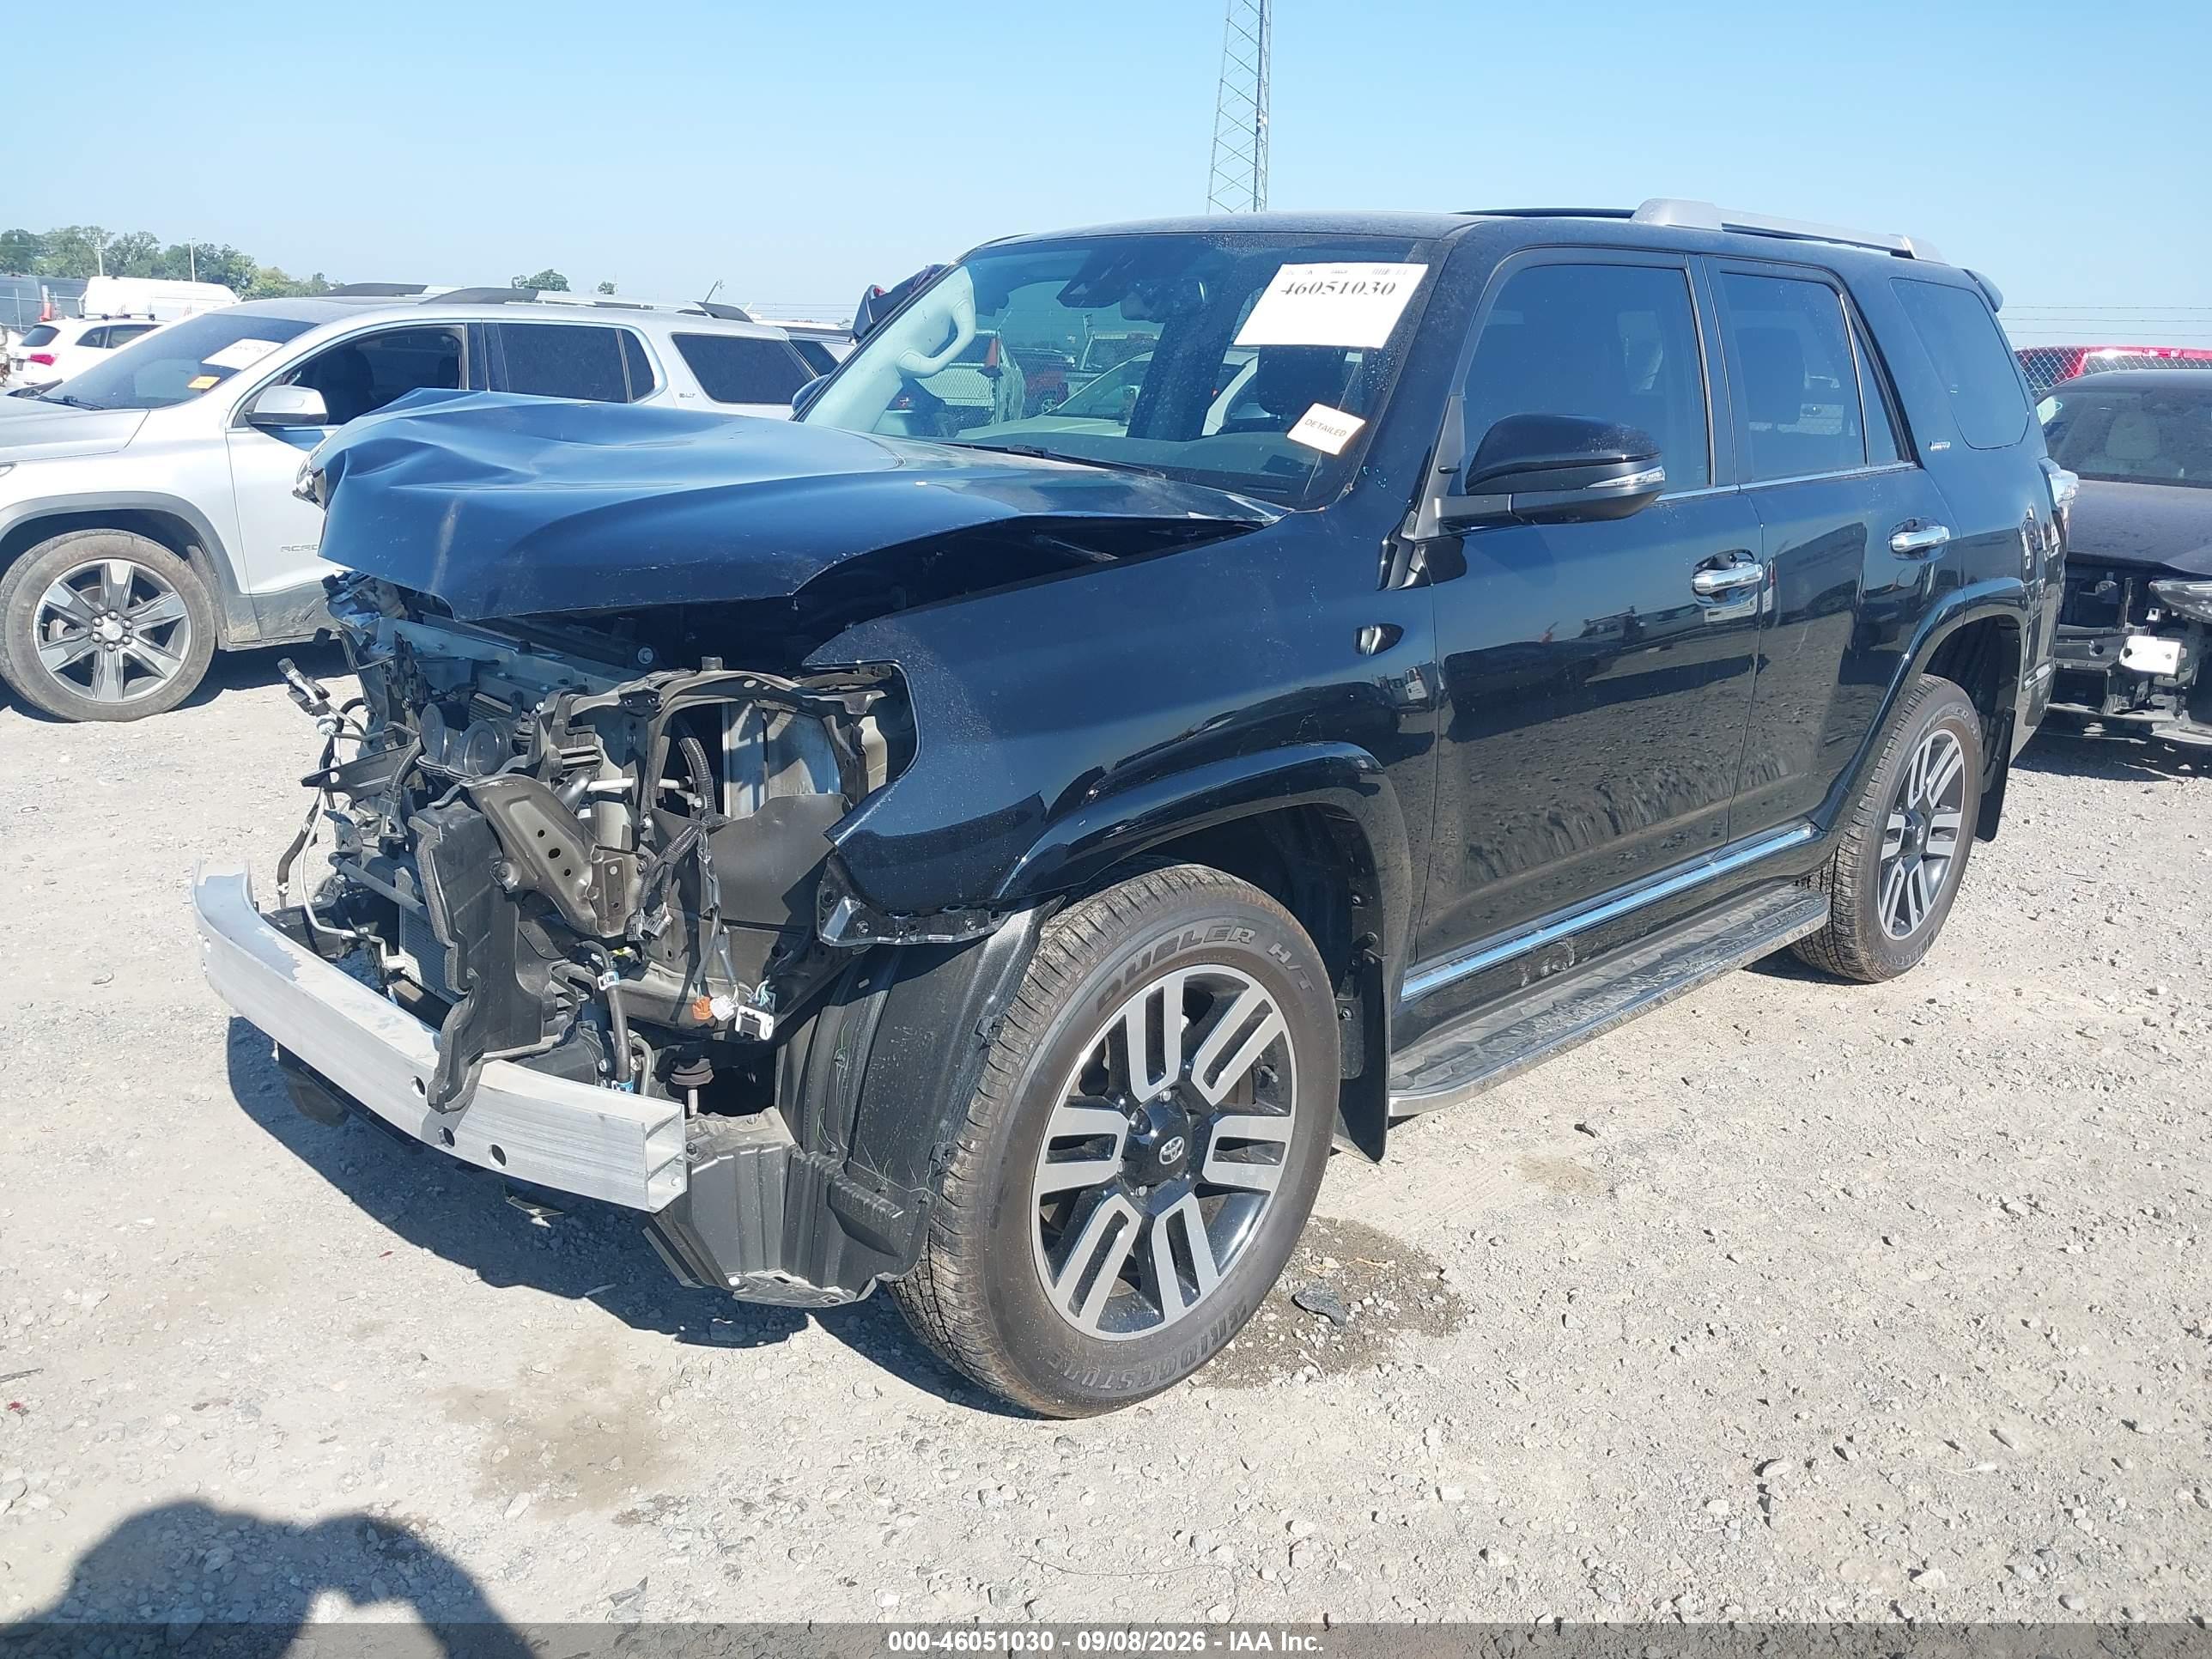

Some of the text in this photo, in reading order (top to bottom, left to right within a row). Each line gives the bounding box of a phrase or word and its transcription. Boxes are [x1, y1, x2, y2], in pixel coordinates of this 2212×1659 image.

[1280, 281, 1396, 295] 46051030
[1304, 418, 1347, 438] DETAILED
[281, 544, 318, 552] ACAD
[1267, 941, 1315, 992] H/T
